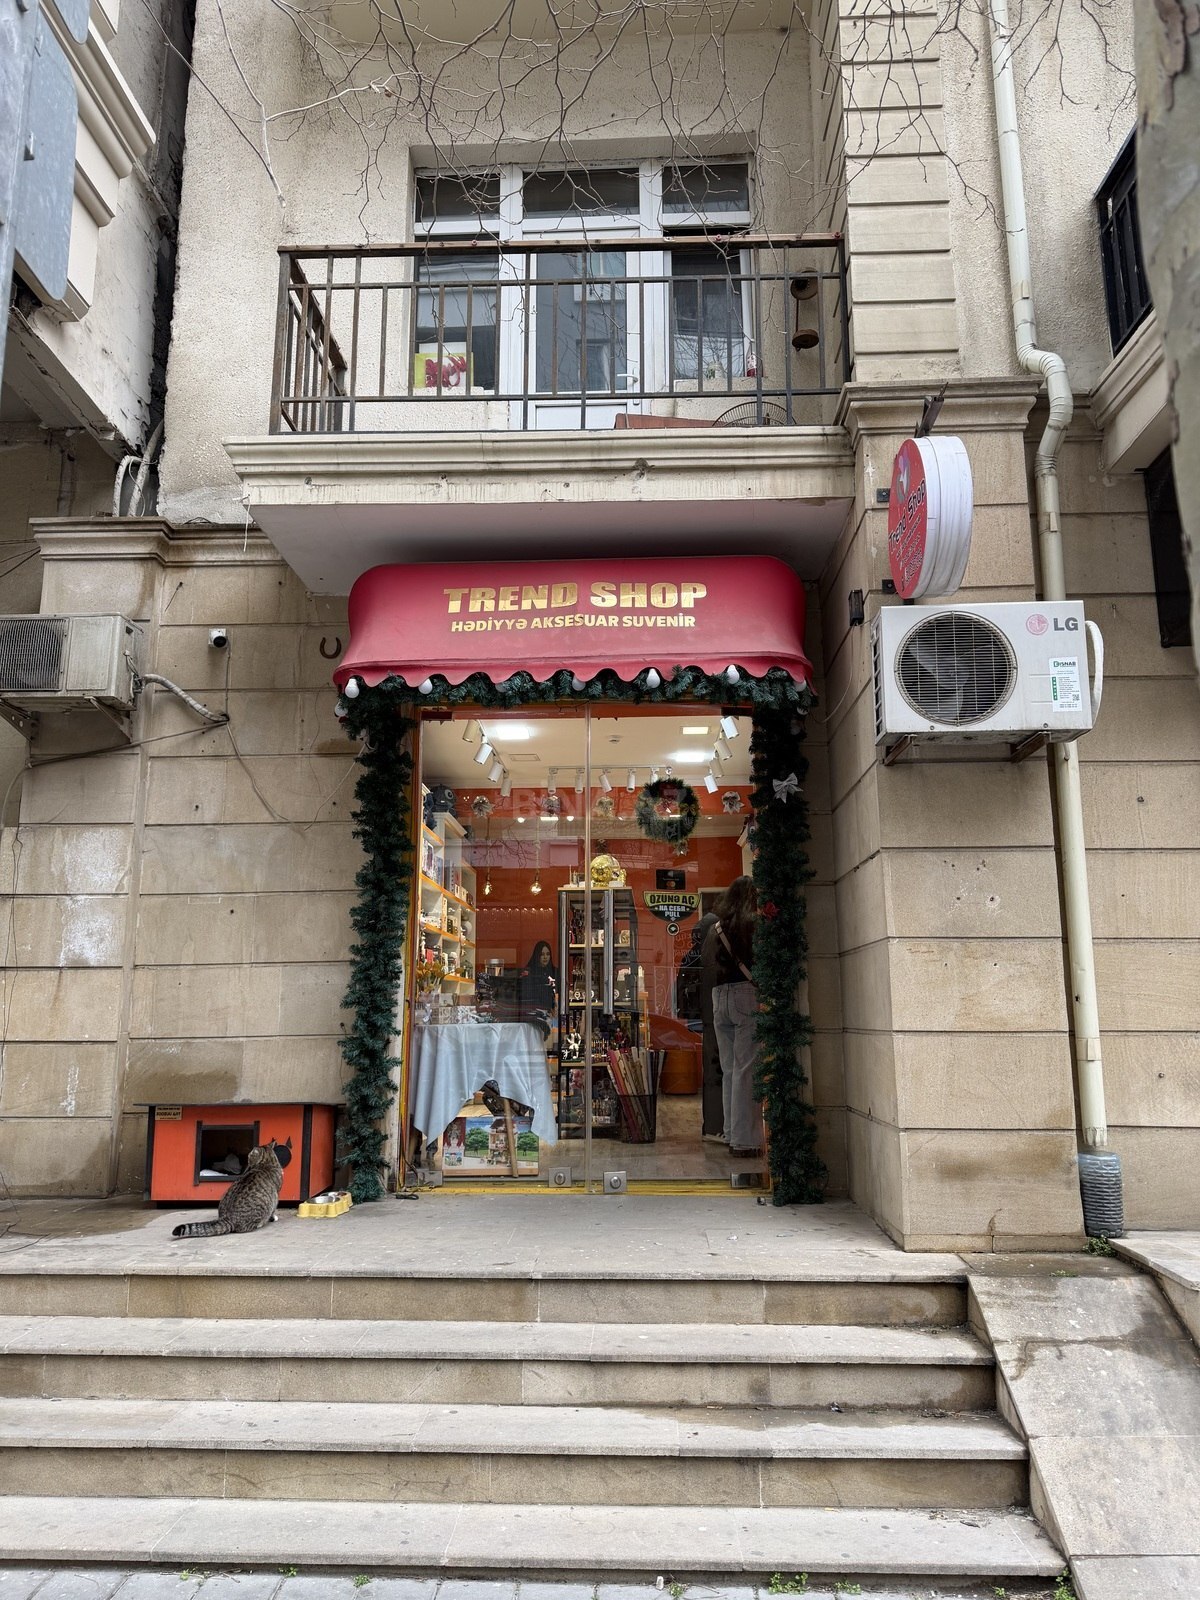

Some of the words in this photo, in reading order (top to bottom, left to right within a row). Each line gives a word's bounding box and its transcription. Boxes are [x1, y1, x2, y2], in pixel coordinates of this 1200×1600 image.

[443, 582, 578, 613] TREND
[590, 582, 708, 609] SHOP
[451, 616, 528, 633] HƏDİYYƏ
[530, 614, 619, 629] AKSESUAR
[622, 612, 696, 628] SUVENİR
[1053, 617, 1079, 631] LG
